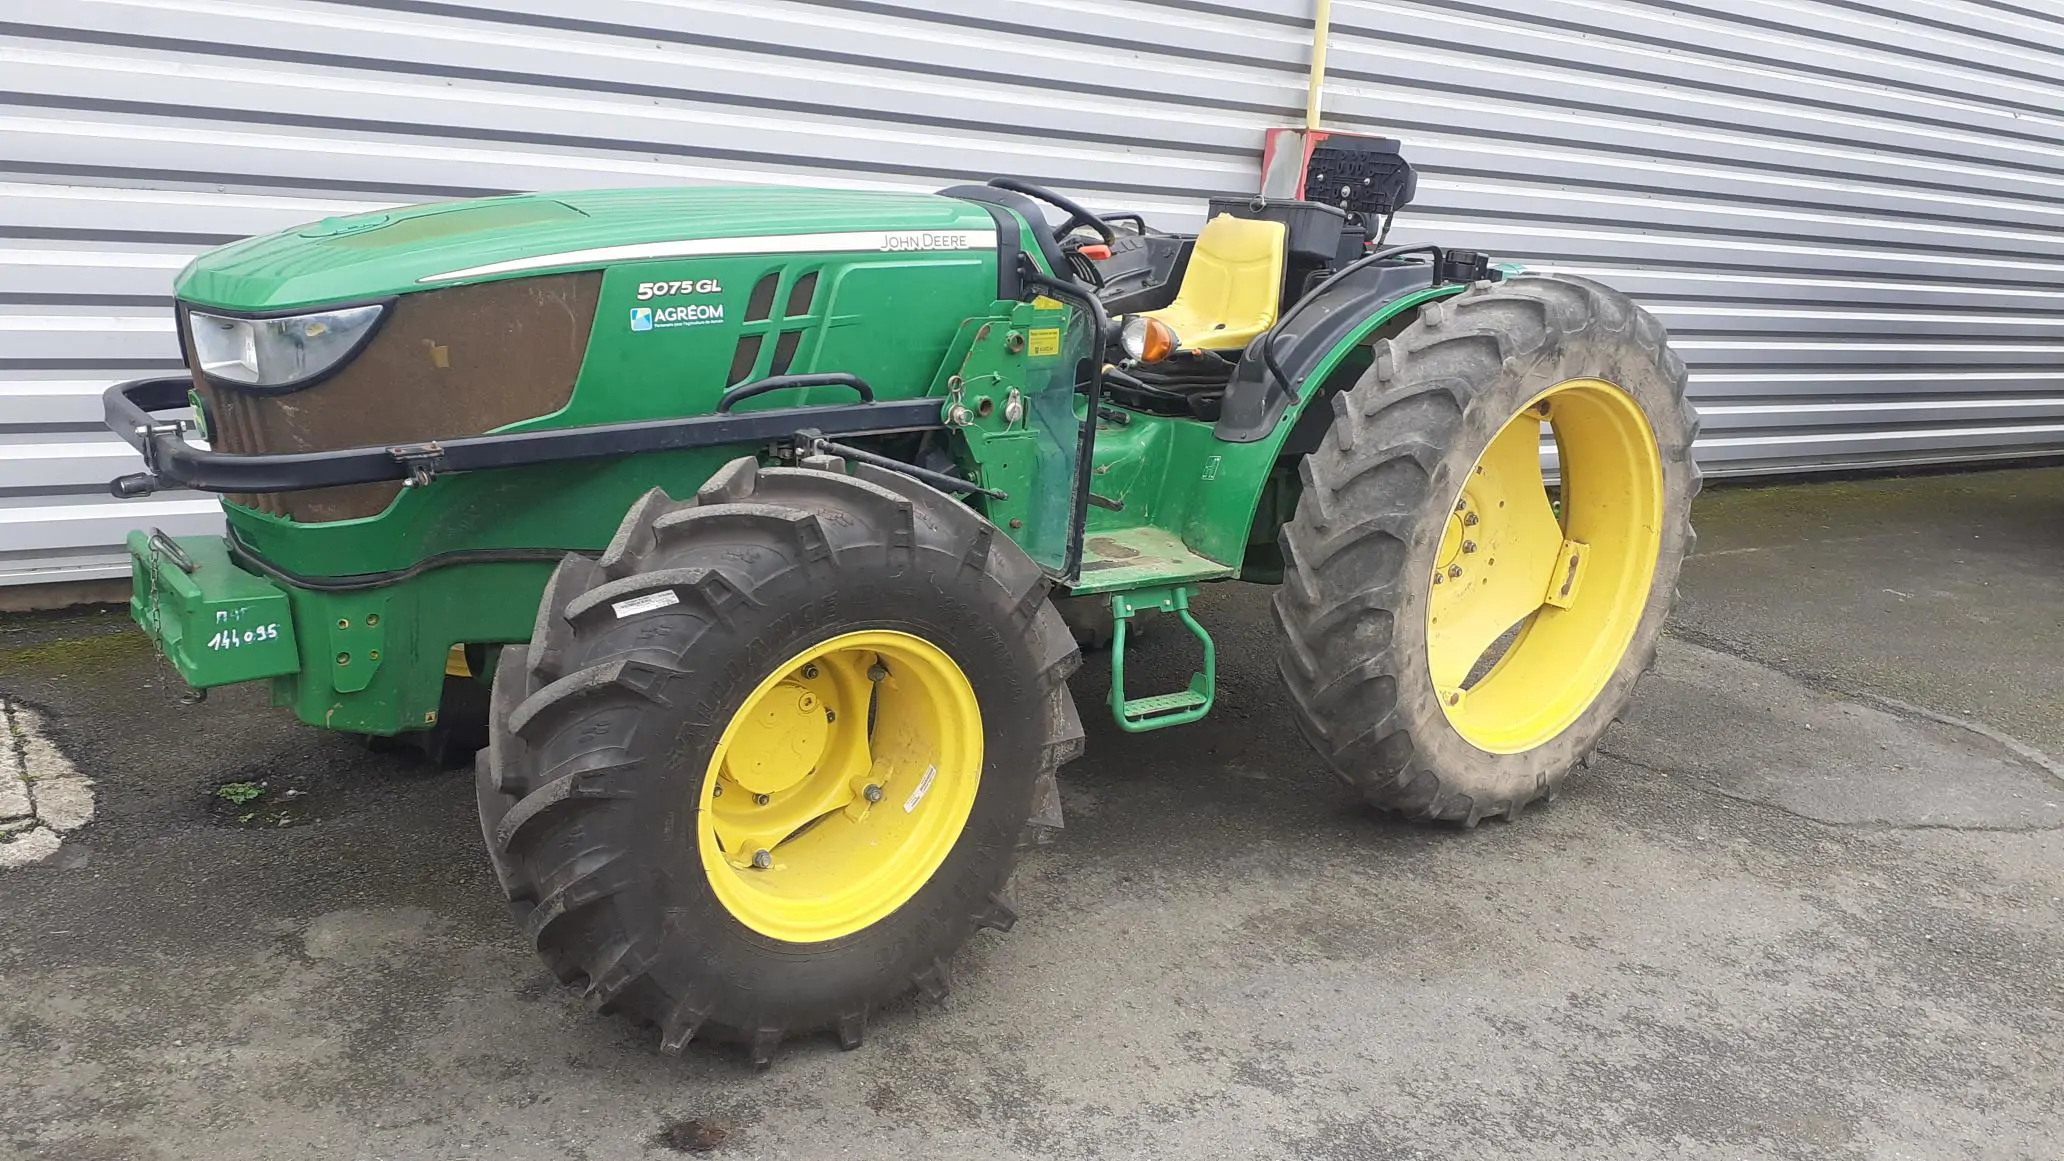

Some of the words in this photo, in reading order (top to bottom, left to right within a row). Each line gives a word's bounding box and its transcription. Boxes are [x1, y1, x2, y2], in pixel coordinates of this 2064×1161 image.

[880, 234, 919, 249] JOHN
[922, 233, 967, 248] DEERE
[637, 280, 693, 301] 5075
[695, 279, 722, 294] GL
[654, 304, 724, 322] AGRÉOM
